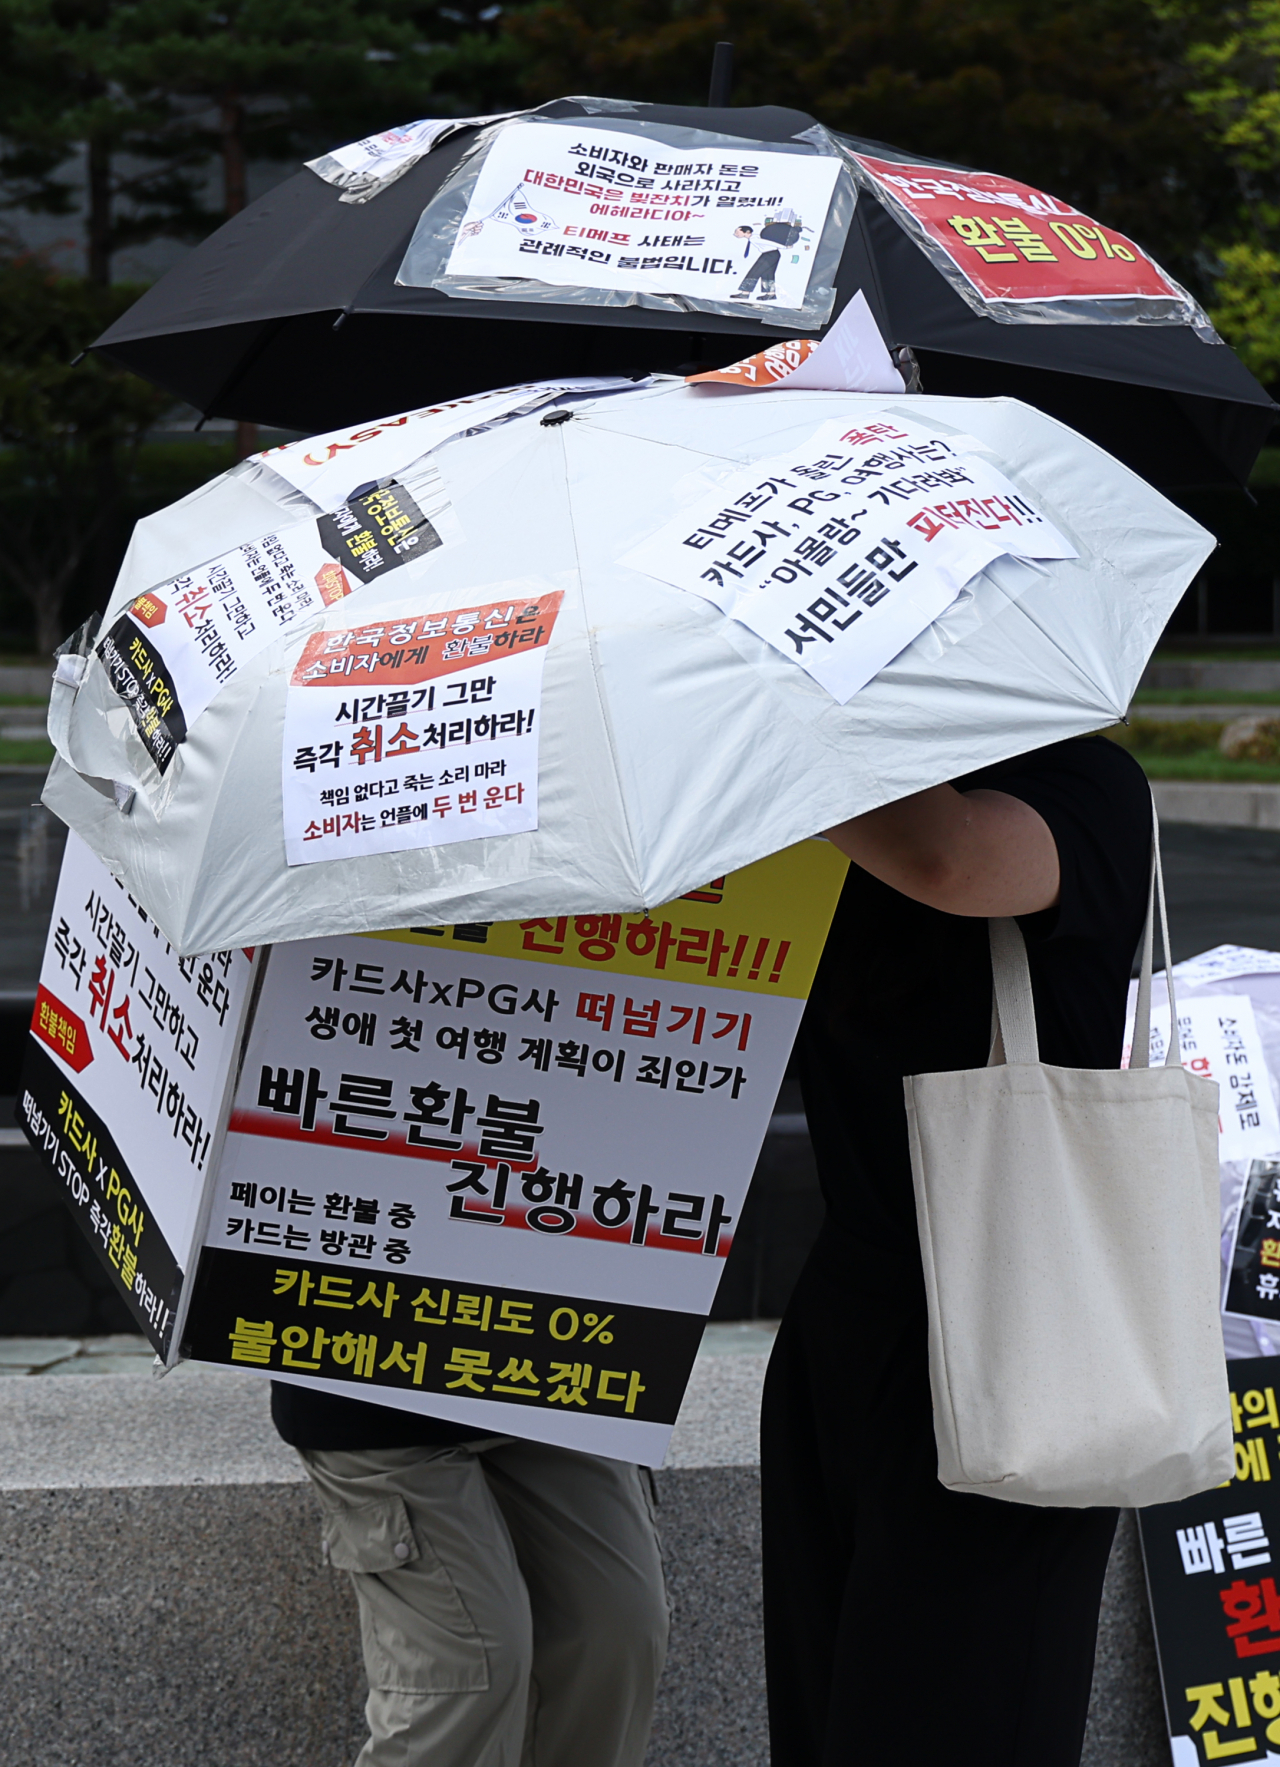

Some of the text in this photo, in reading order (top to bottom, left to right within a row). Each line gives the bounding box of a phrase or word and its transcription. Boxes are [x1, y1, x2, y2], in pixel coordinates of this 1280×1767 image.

[523, 168, 784, 208] 대한민국은 빚잔치가 열렸네!
[568, 142, 759, 178] 소비자와 판매자 돈은
[574, 161, 742, 192] 외국으로 사라지고
[563, 225, 706, 247] 티메프 사태는
[589, 203, 706, 222] 에헤라디야~
[947, 214, 1137, 263] 환불 0%
[518, 238, 738, 275] 관례적인 불법입니다.
[682, 422, 909, 550] 티메프가 돌린 폭탄
[700, 519, 801, 588] 카드사,
[840, 439, 959, 486] 여행사는?
[332, 506, 384, 572] 자에게 환불하라!
[360, 489, 419, 554] 국정보통신은
[251, 565, 274, 588] 언플에
[266, 544, 289, 568] 없다고
[279, 563, 296, 581] 죽는
[784, 495, 1043, 655] 서민들만 피터진다!!
[134, 597, 158, 619] 불책임
[206, 564, 256, 640] 시간끌기 그만하고
[262, 582, 281, 595] 두
[272, 602, 297, 626] 운다
[286, 579, 306, 596] 소리
[294, 591, 314, 611] 마라
[175, 586, 237, 684] 취소처리하라!
[302, 626, 546, 680] 소비자에게 환불하라
[324, 604, 540, 654] 한국정보통신은
[129, 637, 154, 680] 카드사
[150, 678, 174, 717] PG사
[335, 676, 496, 725] 시간끌기 그만
[293, 709, 535, 773] 즉각 취소처리하라!
[303, 782, 525, 841] 소비자는 언플에 두 번 운다
[320, 759, 507, 808] 책임 없다고 죽는 소리 마라
[519, 914, 792, 984] 진행하라!!!
[85, 889, 140, 988] 시간끌기
[138, 967, 199, 1071] 그만하고
[197, 962, 230, 1027] 운다
[309, 955, 753, 1052] 카드사xPG사 떠넘기기
[39, 1001, 77, 1055] 환불책임
[54, 917, 87, 992] 즉각
[88, 954, 211, 1171] 취소처리하라!
[304, 1005, 748, 1101] 생애 첫 여행 계획이 죄인가
[256, 1063, 546, 1162] 빠른환불
[1229, 1073, 1261, 1131] 강제로
[23, 1089, 59, 1165] 떠넘기기
[58, 1150, 90, 1207] STOP
[58, 1090, 97, 1173] 카드사
[106, 1168, 145, 1248] PG사
[229, 1180, 418, 1231] 페이는 환불 중
[444, 1159, 733, 1257] 진행하라
[225, 1216, 413, 1266] 카드는 방관 중
[272, 1266, 616, 1346] 카드사 신뢰도 0%
[227, 1316, 646, 1414] 불안해서 못쓰겠다
[1176, 1511, 1272, 1576] 빠른
